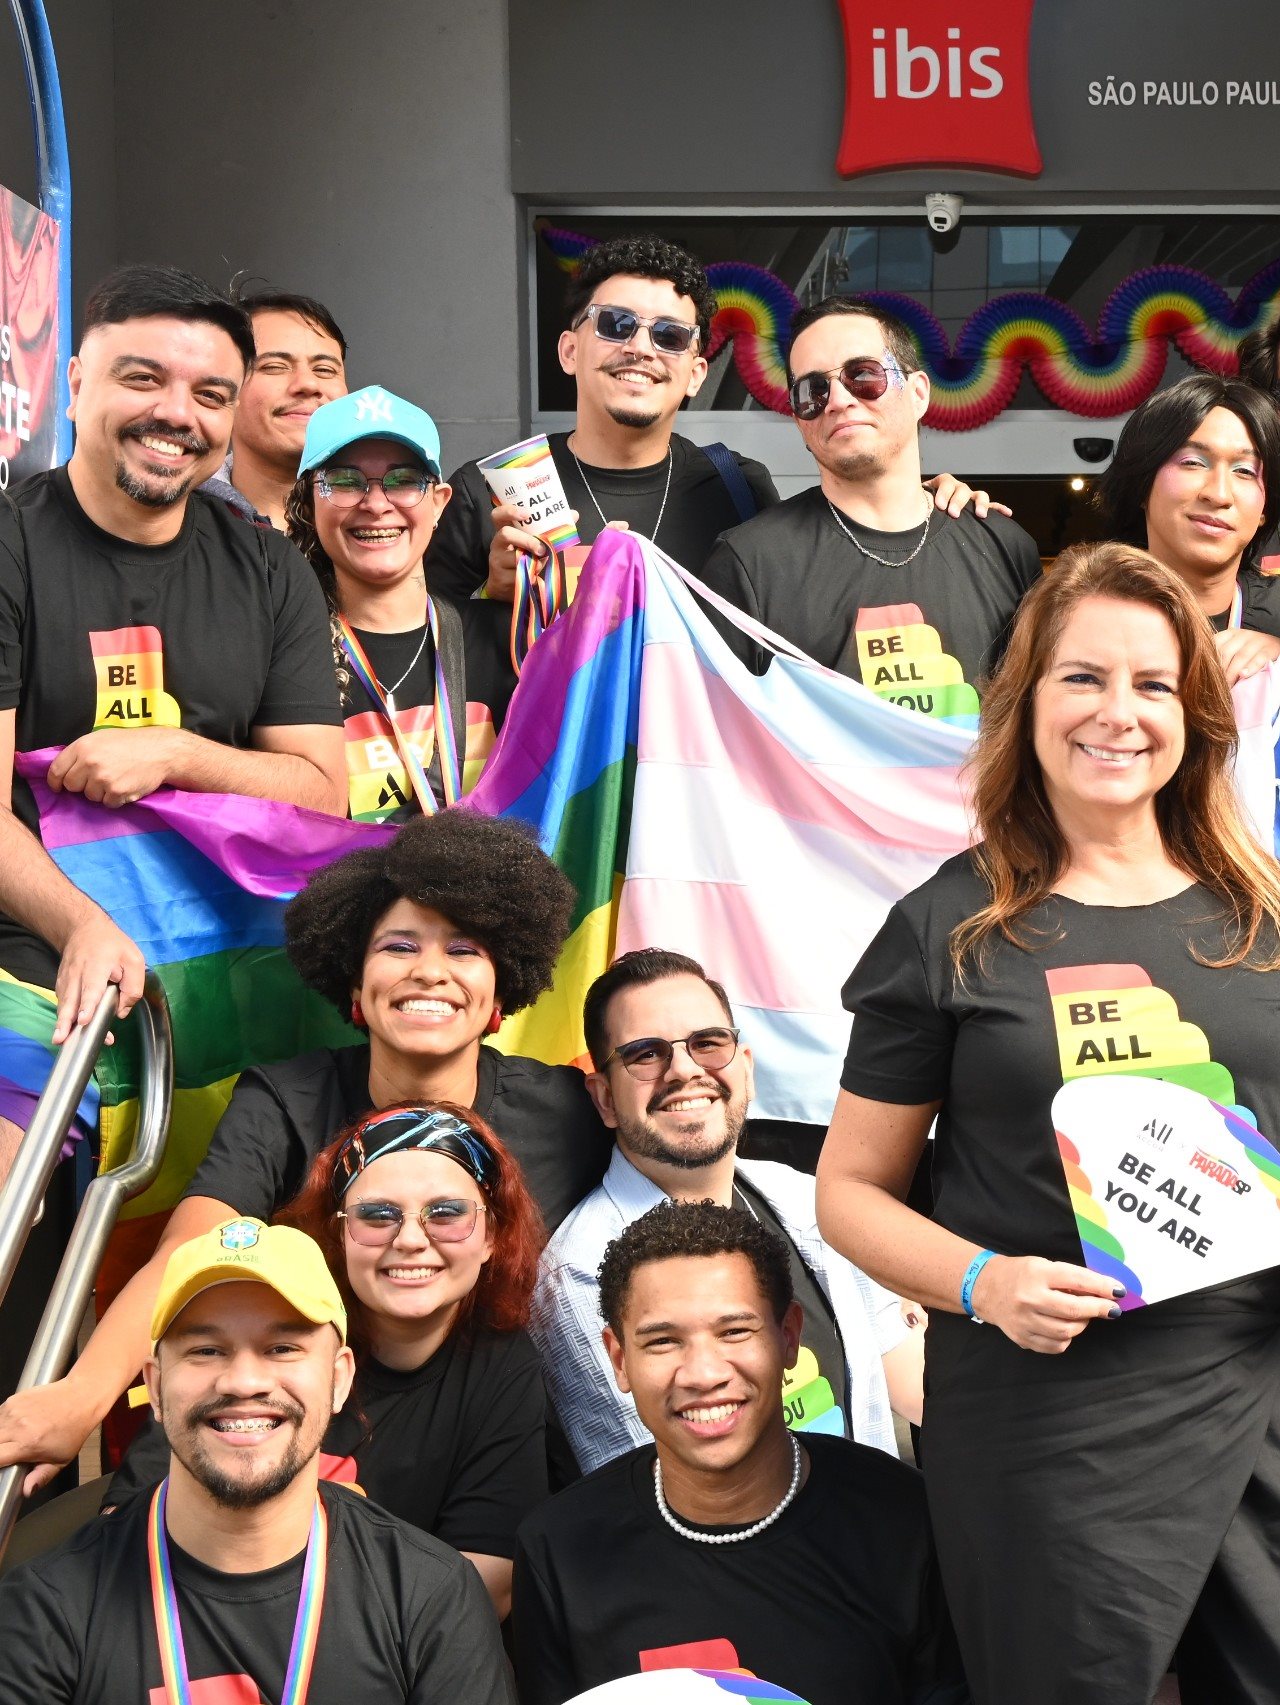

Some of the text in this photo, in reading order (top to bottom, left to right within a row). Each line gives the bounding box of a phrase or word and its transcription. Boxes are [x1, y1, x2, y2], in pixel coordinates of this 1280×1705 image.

[872, 27, 1004, 99] ibis
[1088, 76, 1137, 106] SÃO
[1144, 82, 1219, 106] PAULO
[529, 491, 552, 508] ALL
[545, 500, 565, 518] ARE
[868, 635, 904, 658] BE
[107, 664, 137, 687] BE
[874, 662, 924, 686] ALL
[104, 697, 153, 720] ALL
[1068, 999, 1122, 1026] BE
[1075, 1034, 1152, 1066] ALL
[1117, 1152, 1202, 1217] BE ALL
[1103, 1181, 1214, 1258] YOU ARE
[783, 1396, 805, 1427] OU
